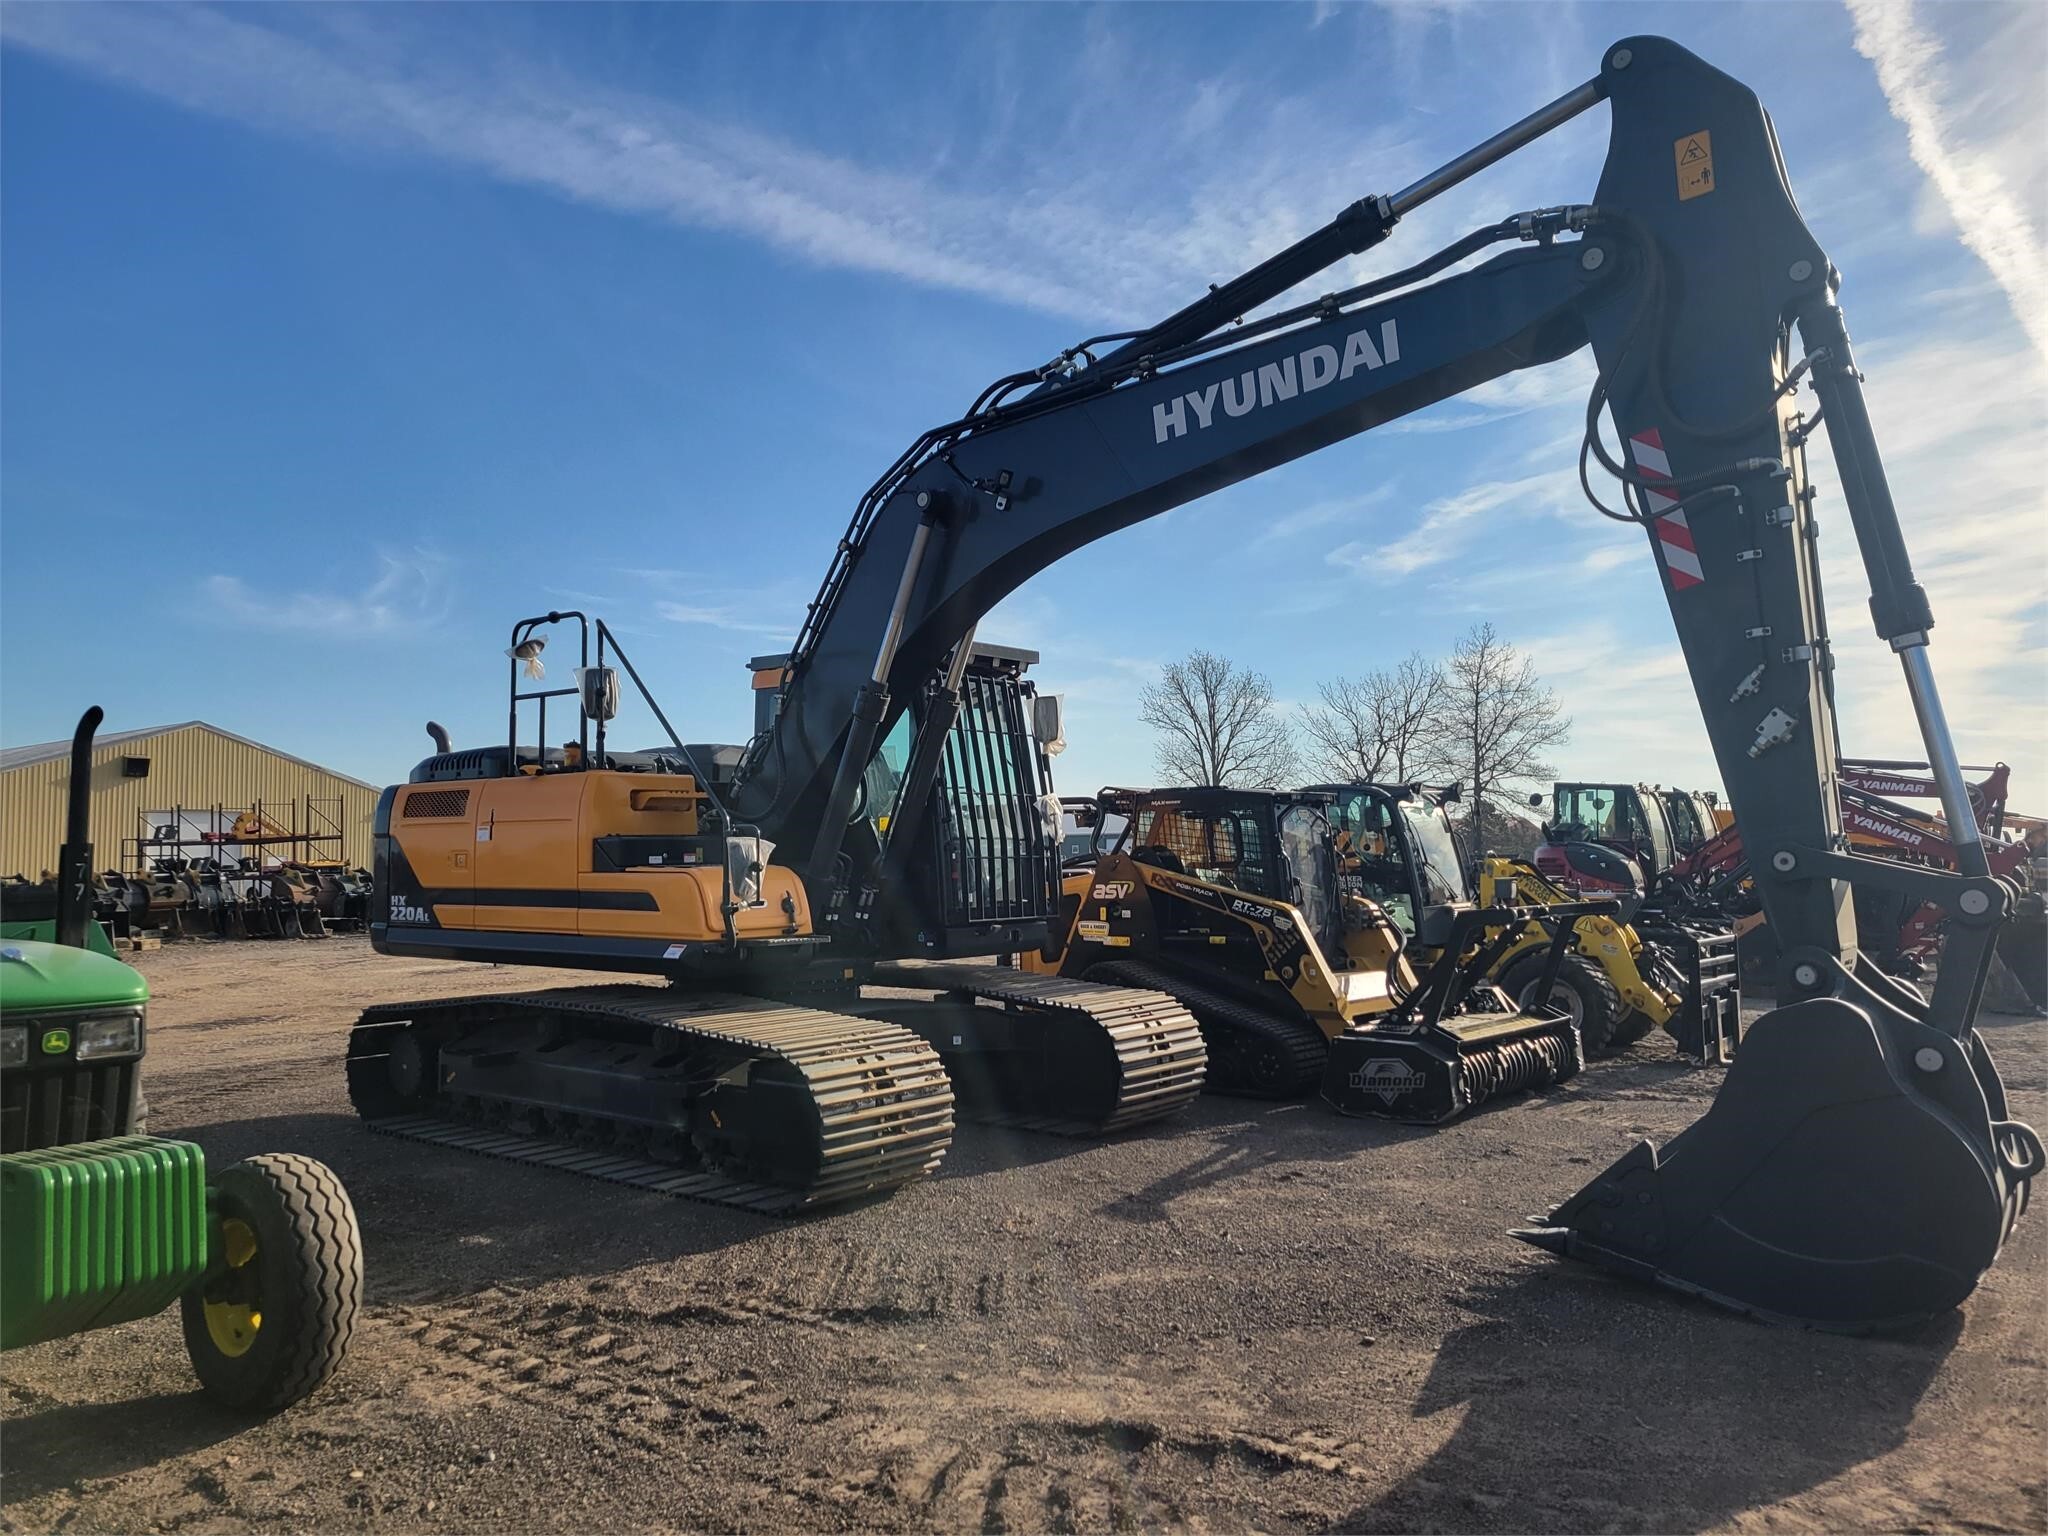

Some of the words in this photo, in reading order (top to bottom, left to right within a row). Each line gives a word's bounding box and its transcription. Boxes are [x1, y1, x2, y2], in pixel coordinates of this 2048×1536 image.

[1152, 318, 1401, 444] HYUNDAI
[1862, 780, 1926, 793] YANMAR
[1854, 814, 1923, 845] YANMAR
[1175, 882, 1214, 897] POSI-TRACK
[391, 895, 407, 906] HX
[1232, 899, 1273, 918] RT-75
[1350, 1072, 1424, 1088] Diamond
